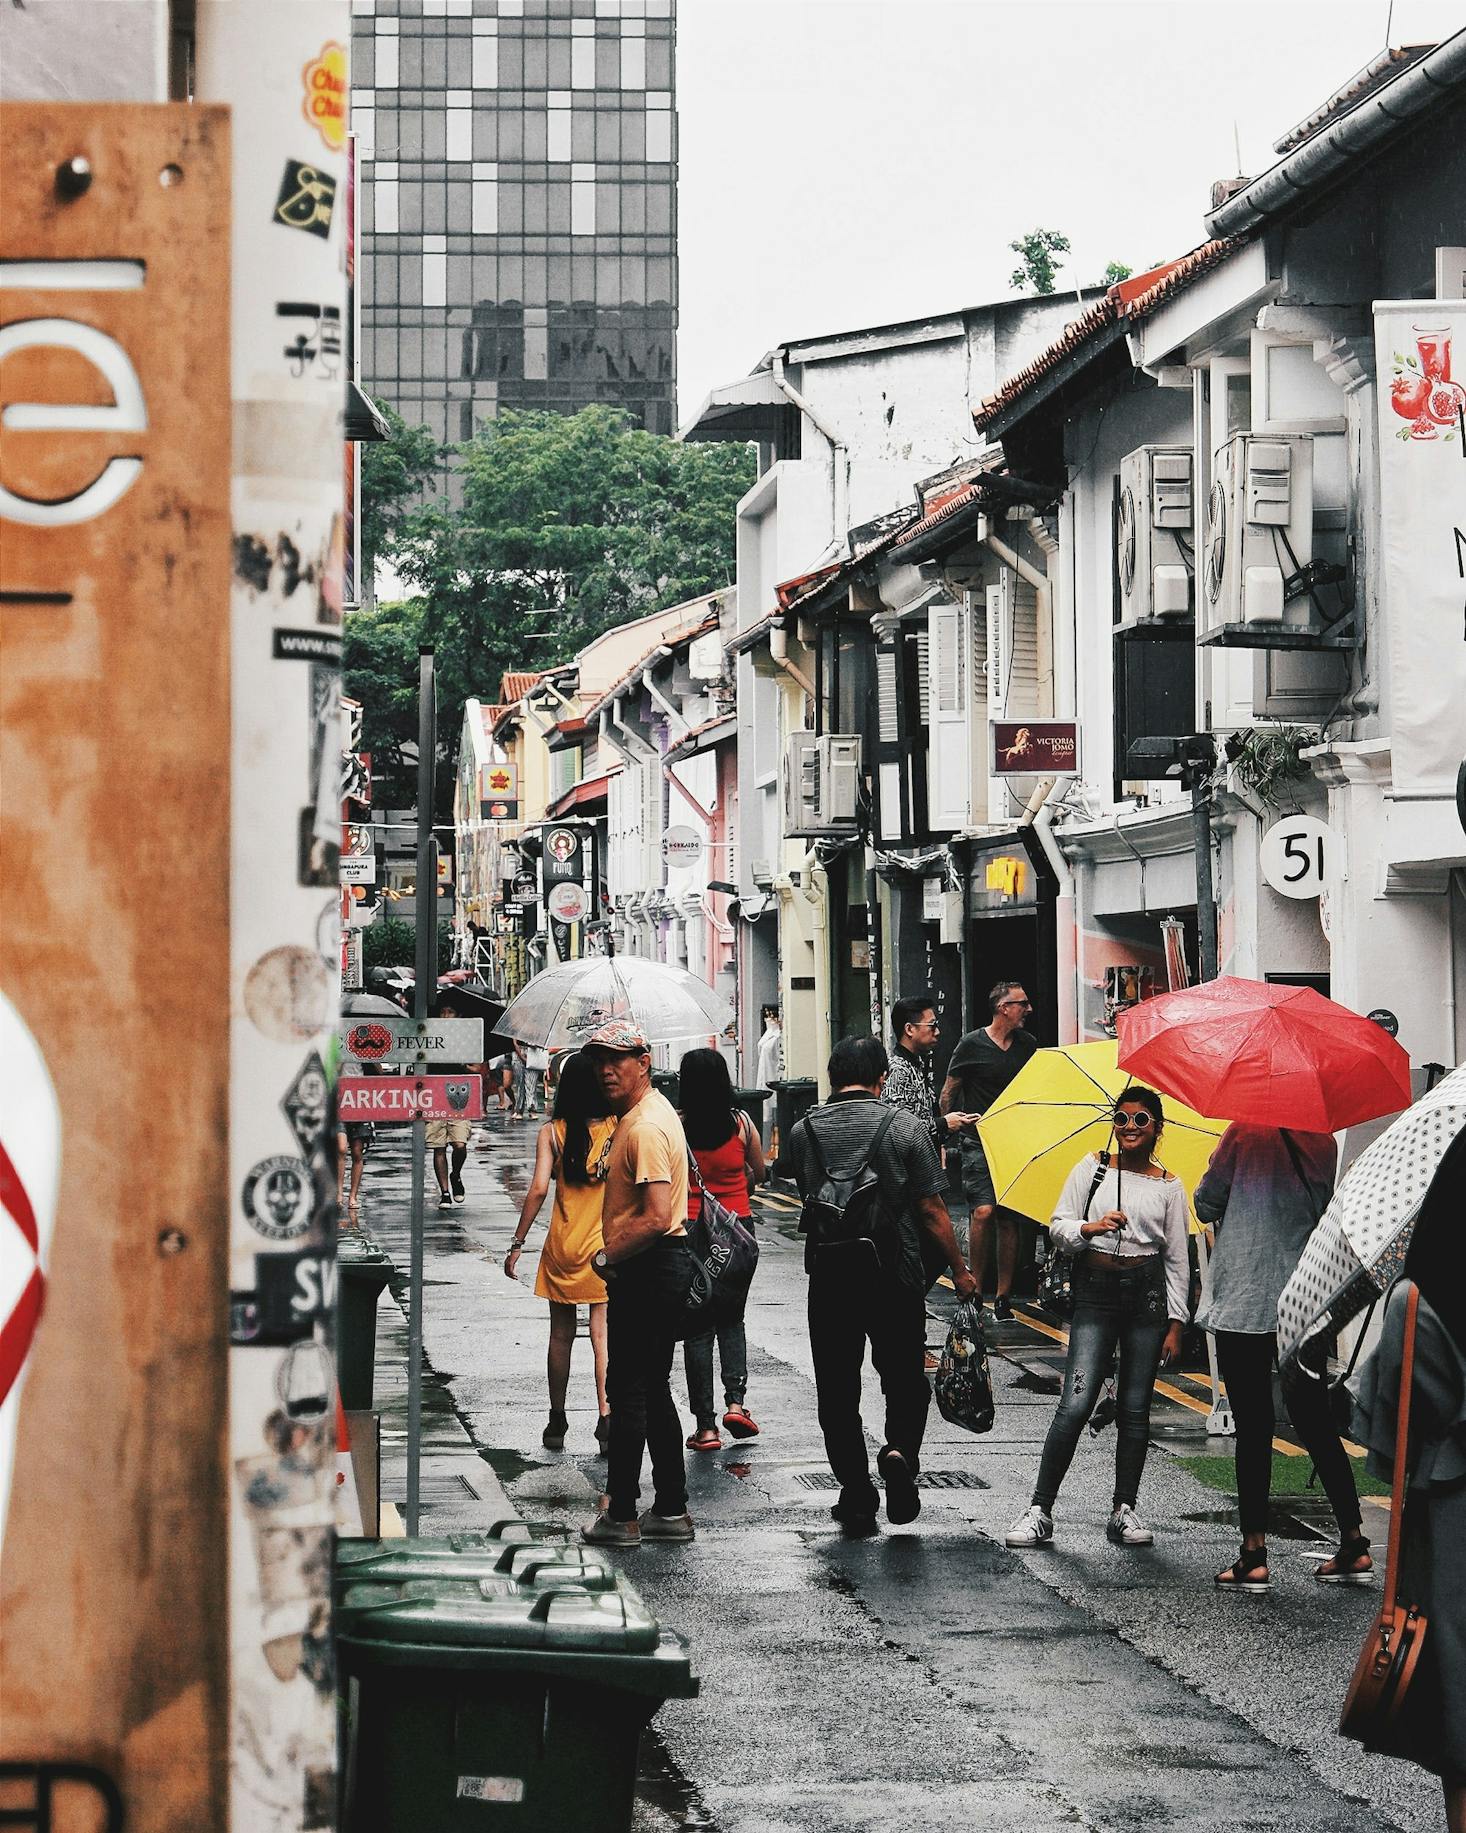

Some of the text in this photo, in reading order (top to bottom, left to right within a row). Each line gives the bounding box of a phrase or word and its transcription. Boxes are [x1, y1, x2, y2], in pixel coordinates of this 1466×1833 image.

[1051, 744, 1075, 752] JOMO
[1280, 833, 1324, 882] 51
[397, 1036, 445, 1049] FEVER
[340, 1089, 433, 1109] ARKING
[408, 1109, 465, 1118] Pease...
